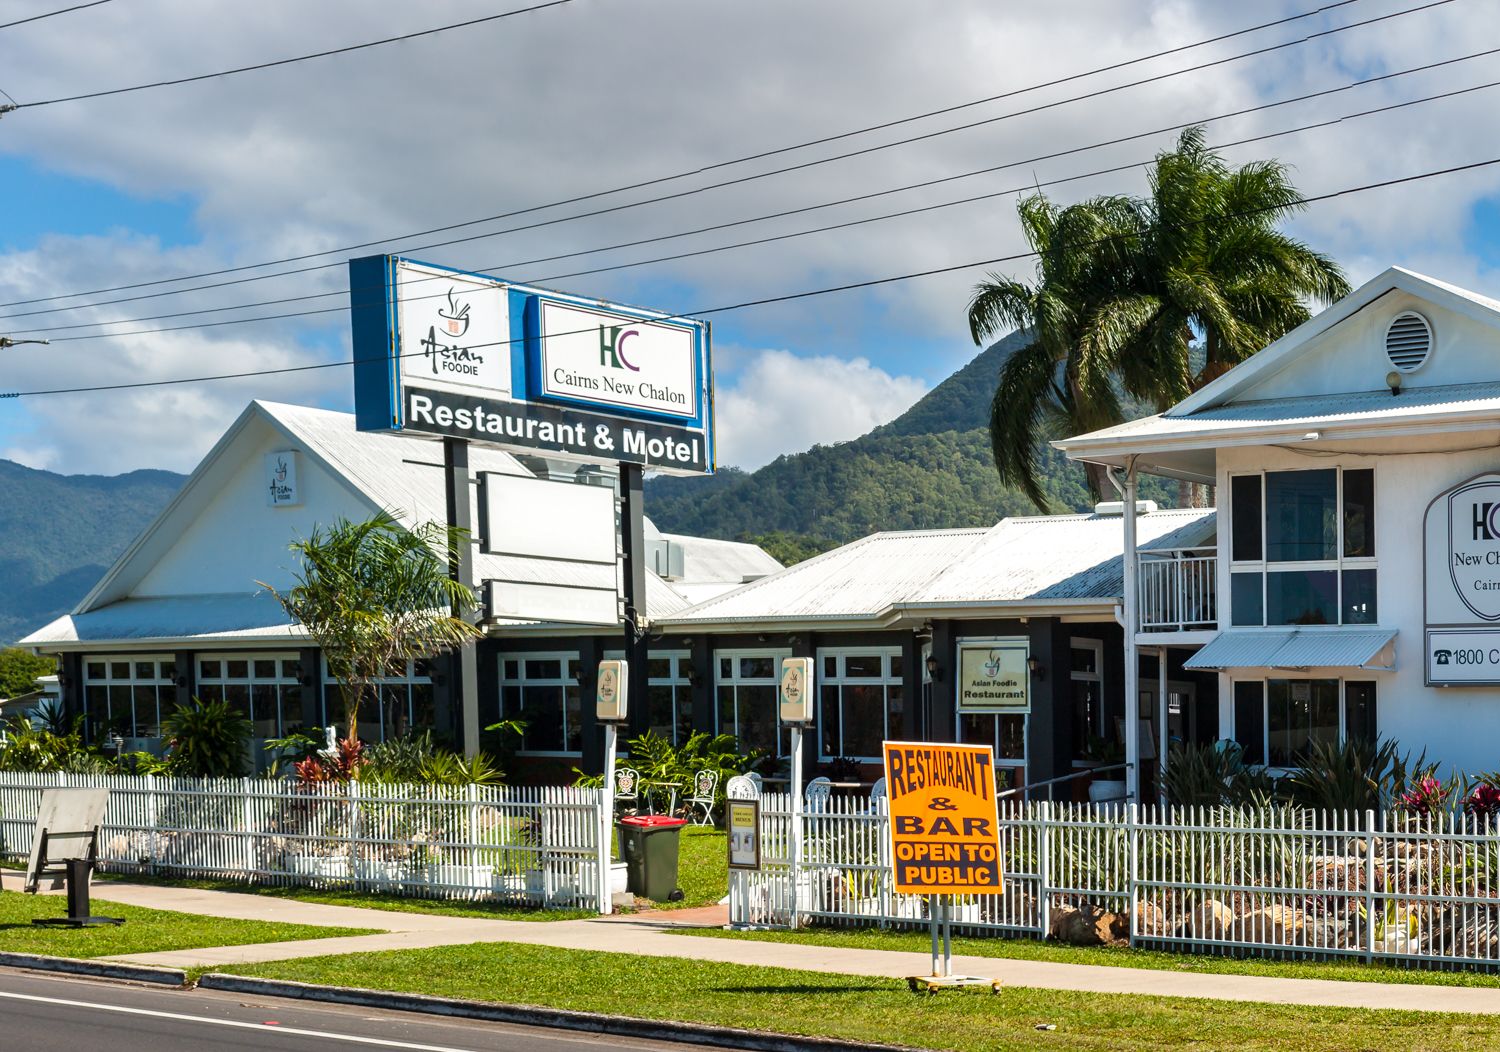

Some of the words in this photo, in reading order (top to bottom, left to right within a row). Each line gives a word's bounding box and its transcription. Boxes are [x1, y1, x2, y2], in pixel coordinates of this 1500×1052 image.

[421, 326, 484, 374] Asian
[442, 361, 479, 376] FOODIE
[554, 368, 599, 390] Cairns
[602, 376, 634, 396] New
[639, 383, 686, 404] Chalon
[410, 394, 586, 446] Restaurant
[593, 425, 615, 451] &
[623, 428, 699, 464] Motel
[1454, 552, 1483, 566] New
[1453, 649, 1483, 665] 1800
[964, 690, 1024, 698] Restaurant
[888, 749, 989, 801] RESTAURANT
[928, 797, 958, 811] &
[895, 816, 992, 837] BAR
[896, 843, 961, 861] OPEN
[964, 844, 996, 862] TO
[905, 866, 991, 885] PUBLIC
